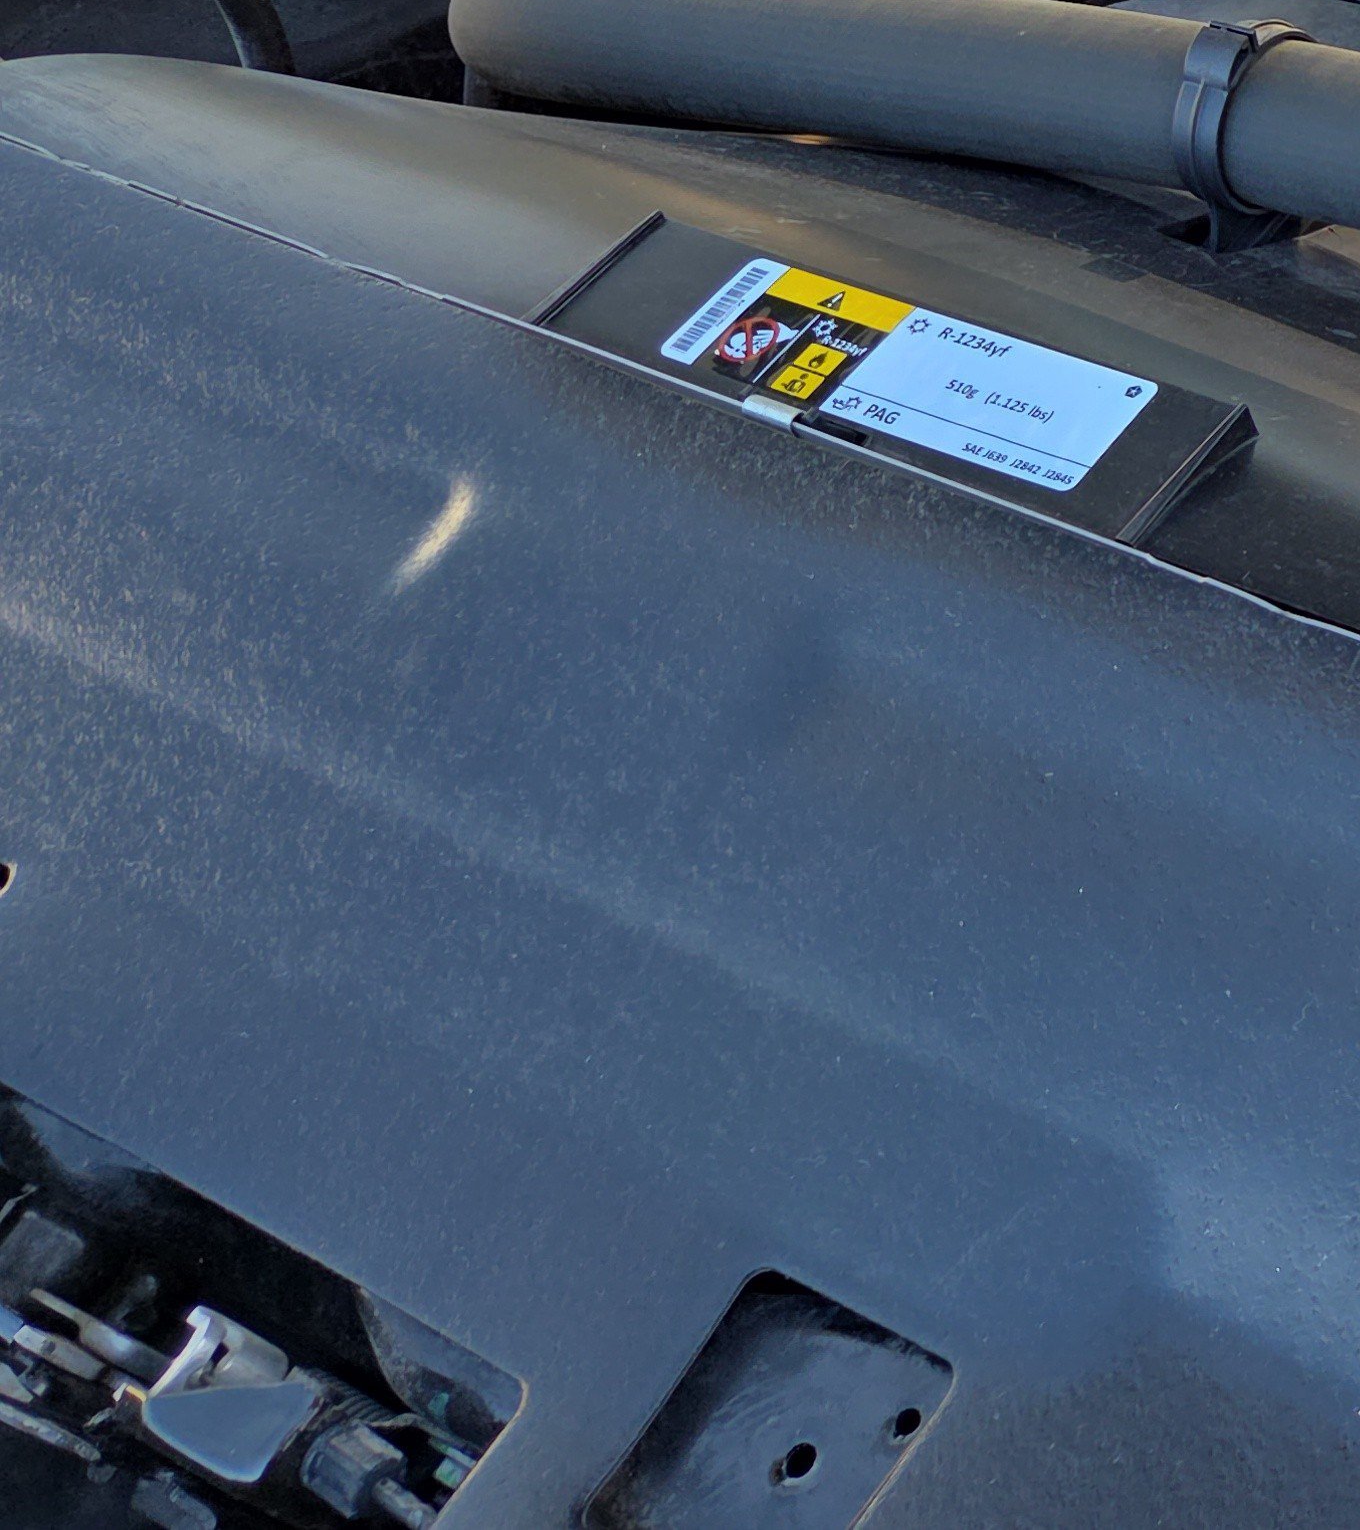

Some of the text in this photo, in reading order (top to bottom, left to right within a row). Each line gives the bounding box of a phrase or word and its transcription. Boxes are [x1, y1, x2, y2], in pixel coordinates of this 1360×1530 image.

[820, 334, 868, 357] R-1234yf
[938, 327, 1013, 358] R-1234yf
[863, 403, 901, 425] PAG
[945, 379, 1055, 424] 510g (1.125 lbs)
[961, 442, 1075, 485] SAE J639 J2842 J2845
